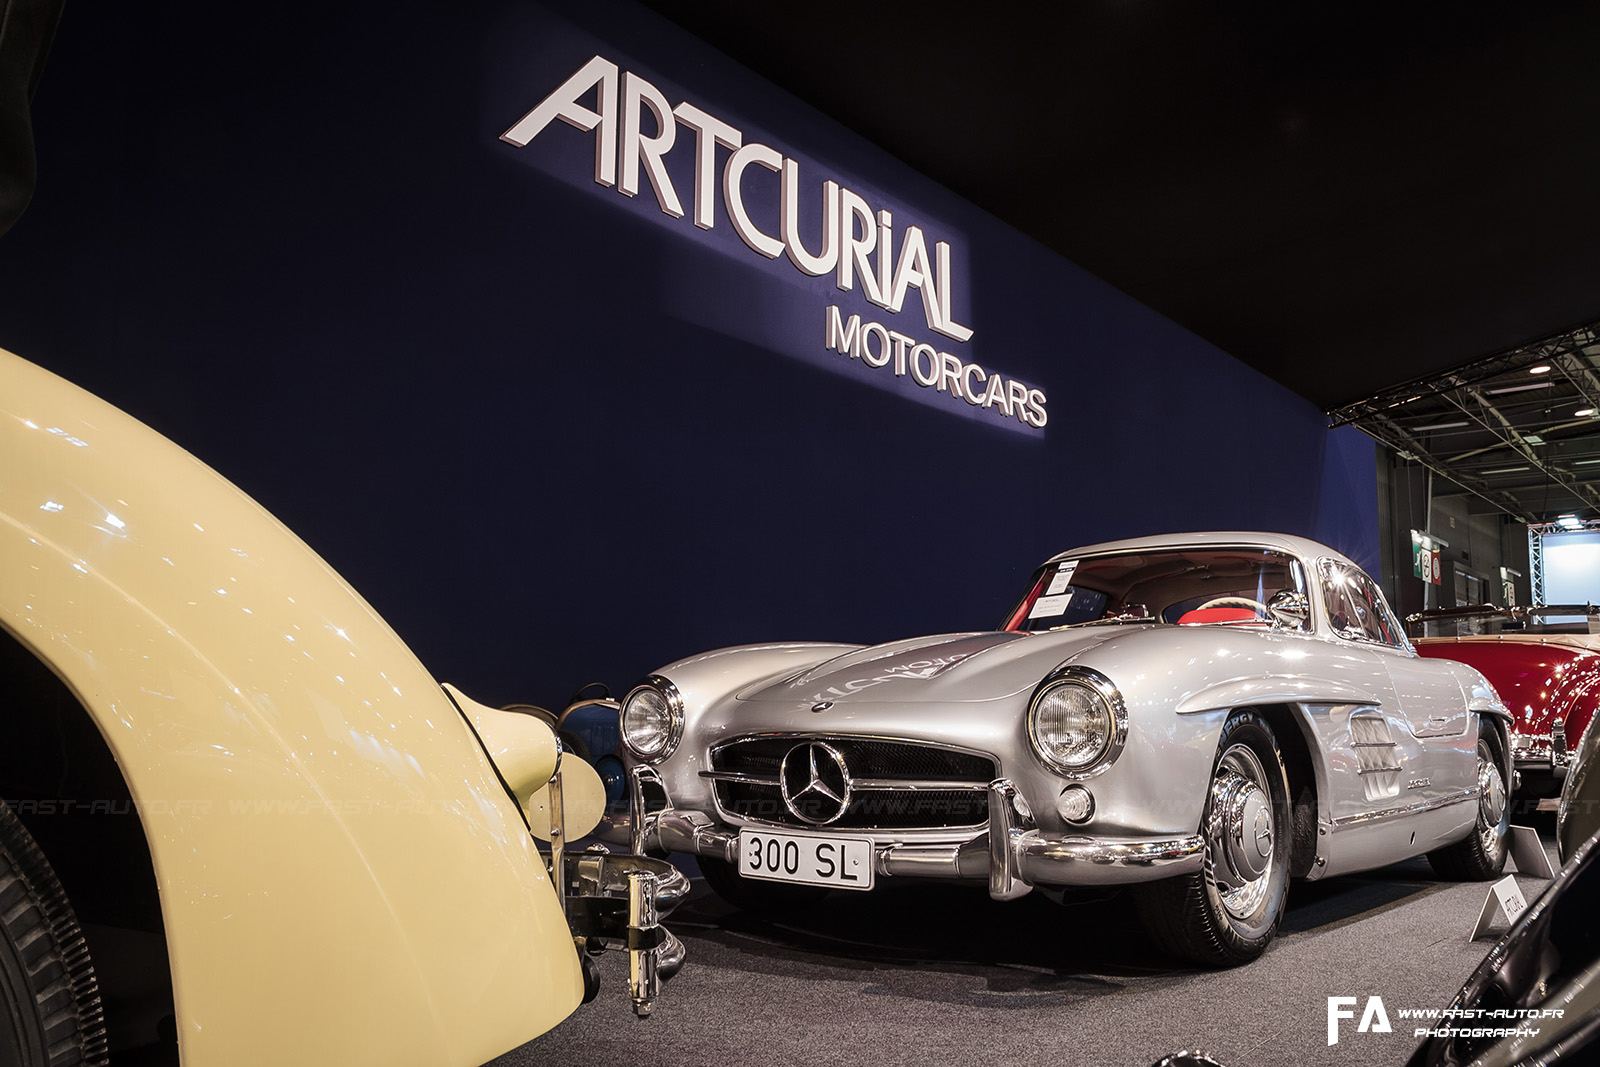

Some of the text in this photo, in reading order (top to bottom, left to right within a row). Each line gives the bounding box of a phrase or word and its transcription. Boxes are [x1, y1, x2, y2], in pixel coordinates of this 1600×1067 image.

[825, 305, 1048, 428] MOTORCARS
[749, 837, 858, 881] 300 SL
